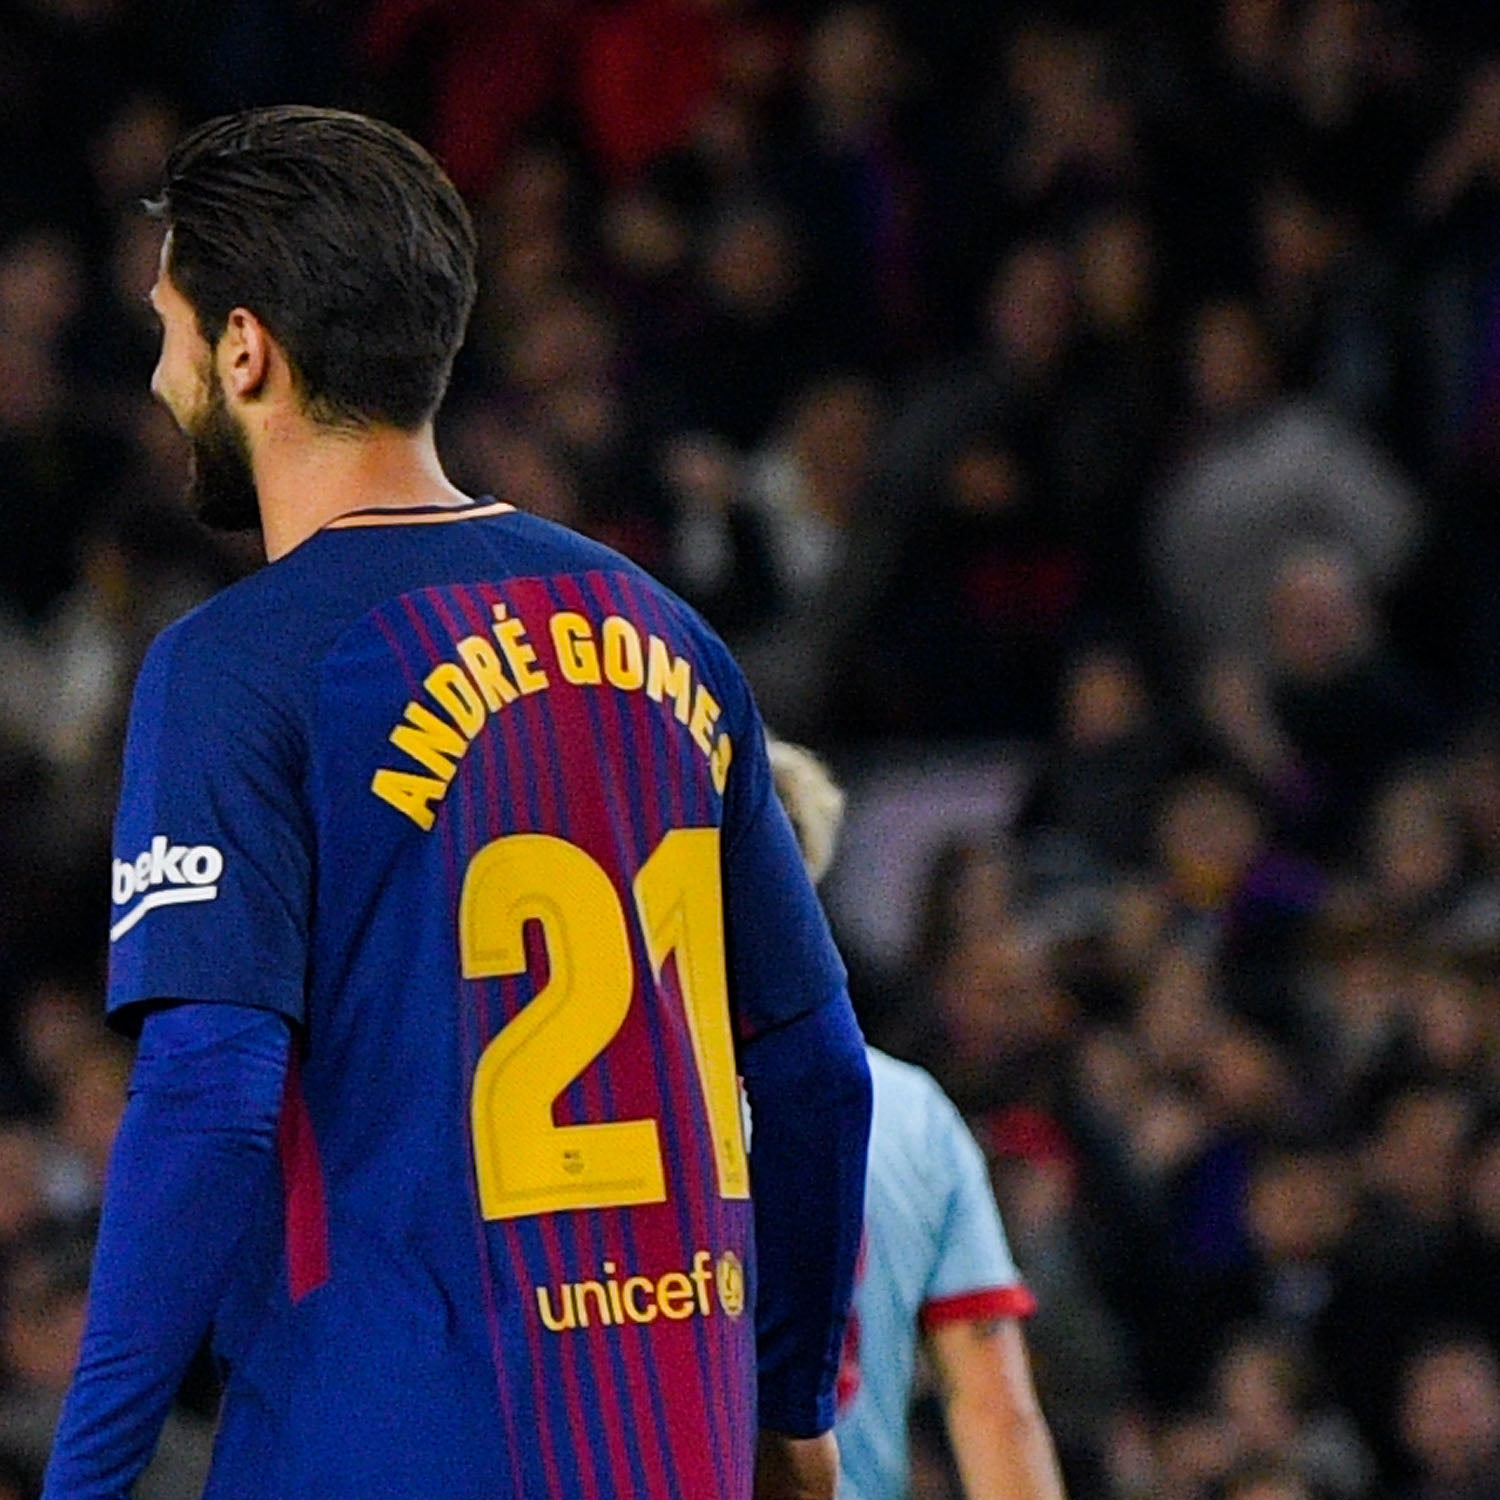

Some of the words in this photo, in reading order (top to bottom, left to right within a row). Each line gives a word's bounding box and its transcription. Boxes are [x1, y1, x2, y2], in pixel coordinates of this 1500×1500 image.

[371, 603, 550, 831] ANDRÉ
[549, 612, 733, 796] GOMES
[111, 835, 223, 906] beko
[460, 827, 750, 1221] 21
[536, 1249, 713, 1333] unicef
